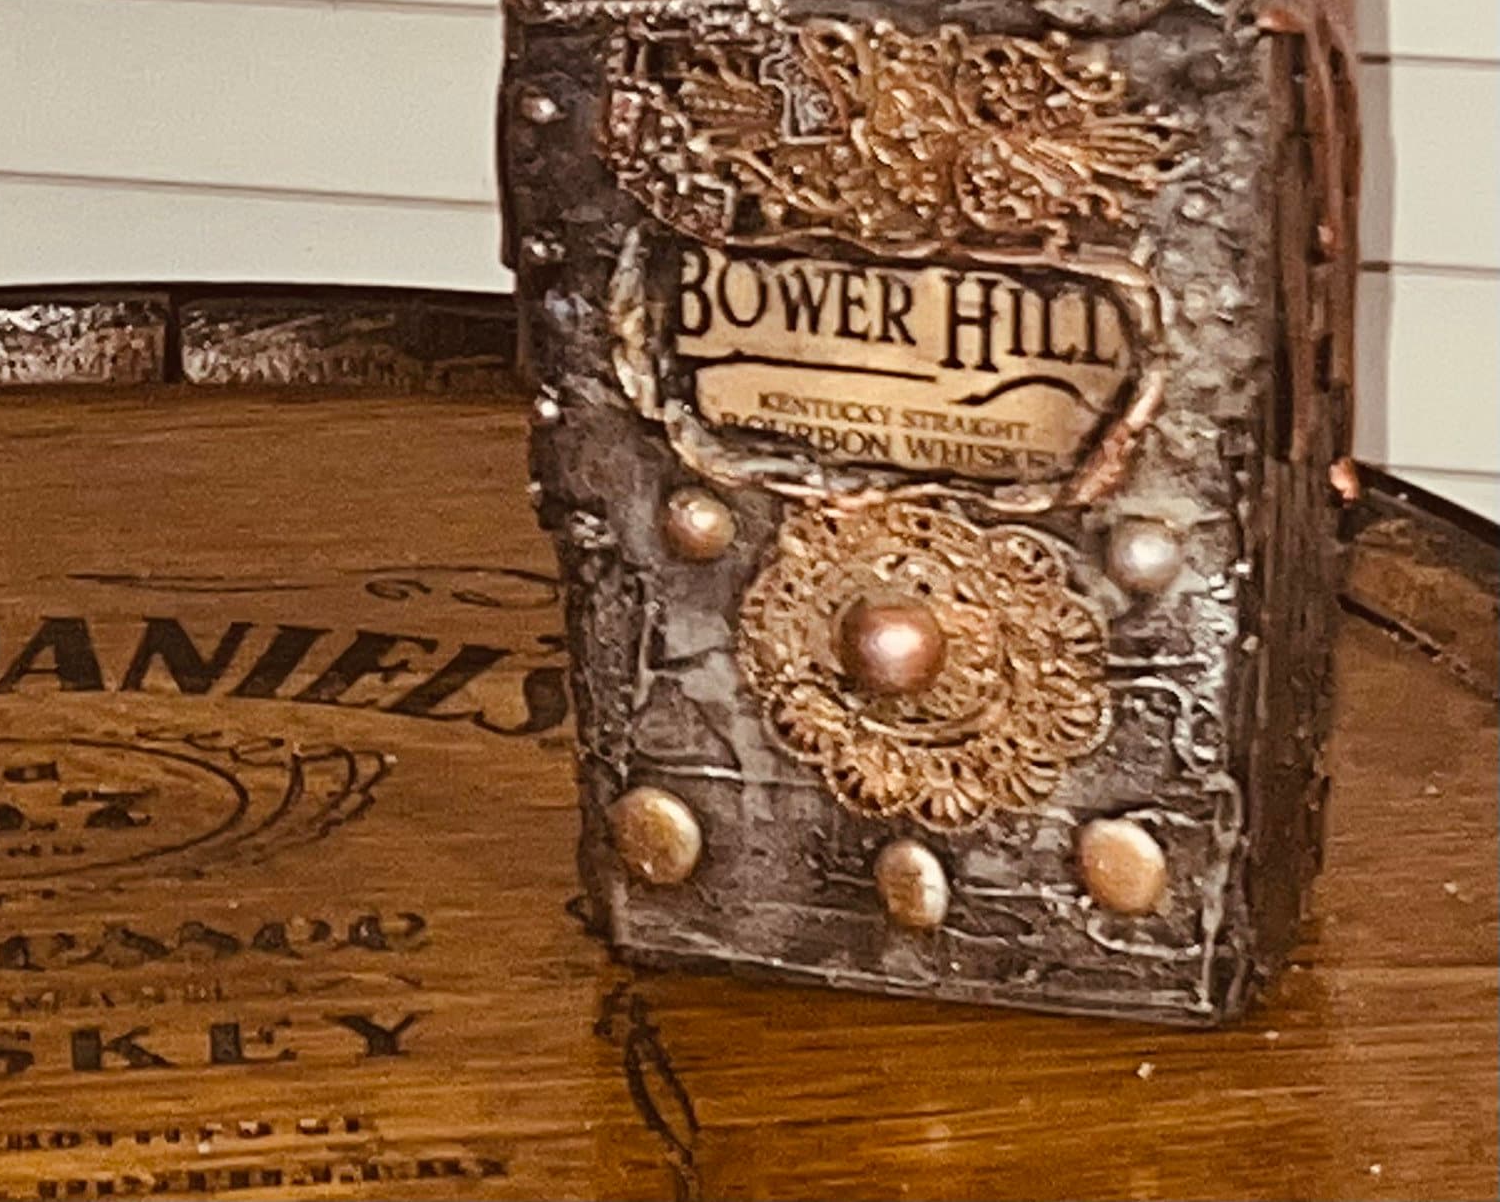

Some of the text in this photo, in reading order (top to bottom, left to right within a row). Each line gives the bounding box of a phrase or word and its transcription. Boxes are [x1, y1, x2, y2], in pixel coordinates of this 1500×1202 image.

[678, 247, 1120, 373] BOWER HILL
[901, 409, 1031, 441] STRAIGHT
